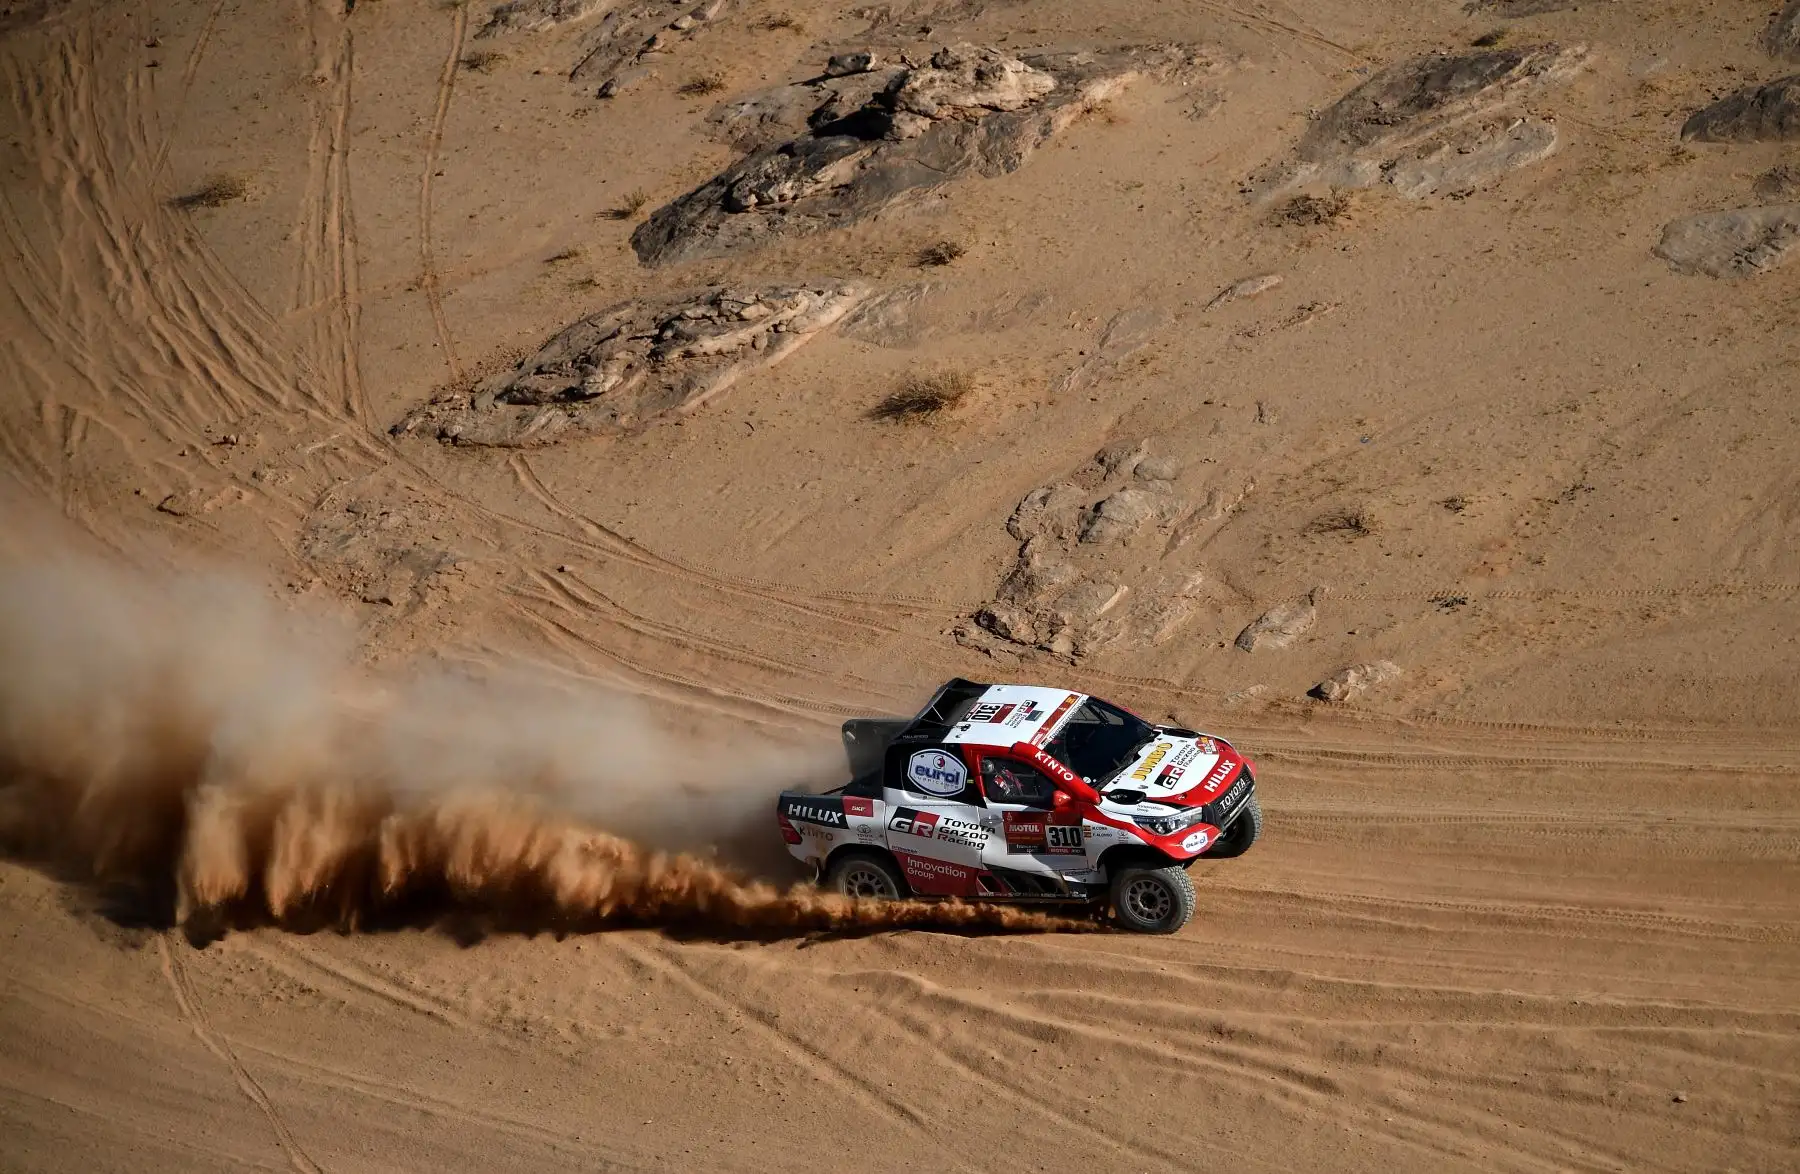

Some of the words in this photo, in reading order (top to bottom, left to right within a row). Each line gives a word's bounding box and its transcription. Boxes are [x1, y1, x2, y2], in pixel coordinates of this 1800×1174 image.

[970, 704, 1001, 721] 310
[1130, 742, 1173, 782] JUMBO
[1170, 743, 1192, 764] TOYOTA
[1176, 746, 1196, 766] GAZOO
[915, 764, 961, 786] eurol
[1034, 751, 1074, 781] KINTO
[1204, 759, 1236, 793] HILUX
[1219, 778, 1247, 810] TOYOTA
[787, 803, 843, 824] HILUX
[888, 816, 935, 838] GR
[939, 826, 989, 841] GAZOO
[943, 817, 996, 834] TOYOTA
[1008, 824, 1040, 833] MOTUL
[937, 833, 986, 851] Racing
[1048, 826, 1083, 847] 310
[907, 856, 967, 879] Innovation
[907, 867, 935, 880] Group
